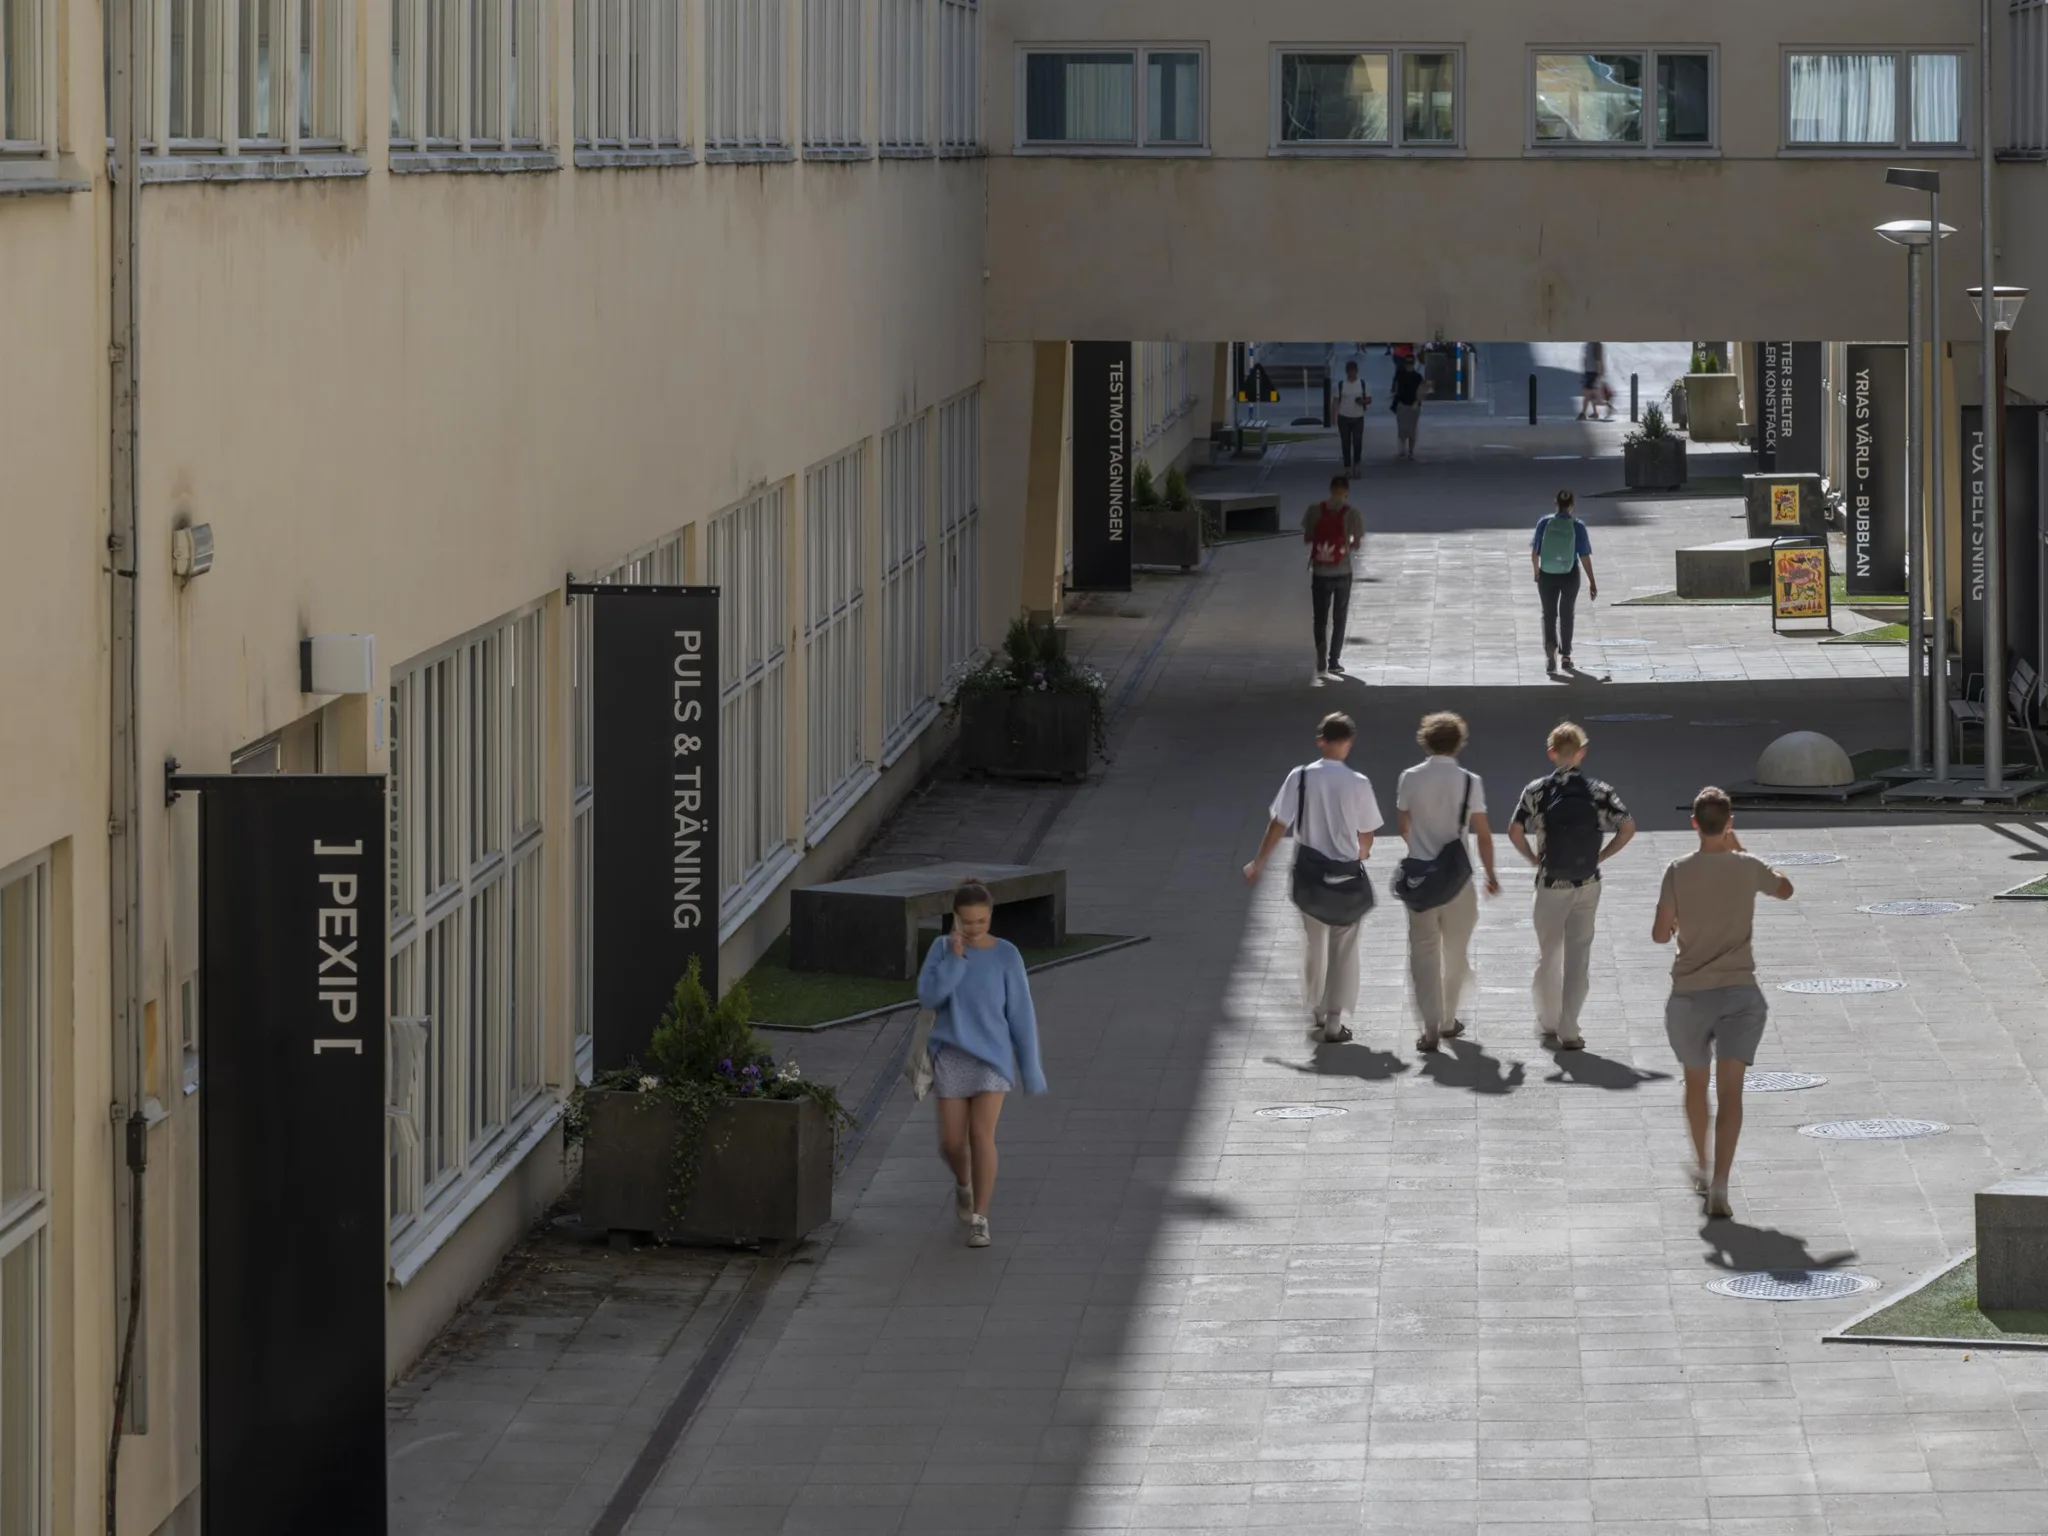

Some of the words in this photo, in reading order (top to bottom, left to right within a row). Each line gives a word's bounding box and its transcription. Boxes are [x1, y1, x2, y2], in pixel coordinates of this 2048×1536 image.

[1765, 370, 1776, 448] KONSTFACK
[1781, 378, 1792, 437] SHELTER
[1855, 368, 1869, 420] YRIAS
[1109, 360, 1124, 541] TESTMOTTAGNINGEN
[1855, 423, 1873, 480] VÄRLD
[1855, 497, 1870, 578] BUBBLAN
[674, 630, 702, 722] PULS
[674, 733, 702, 757] &
[674, 766, 708, 929] TRÄNING
